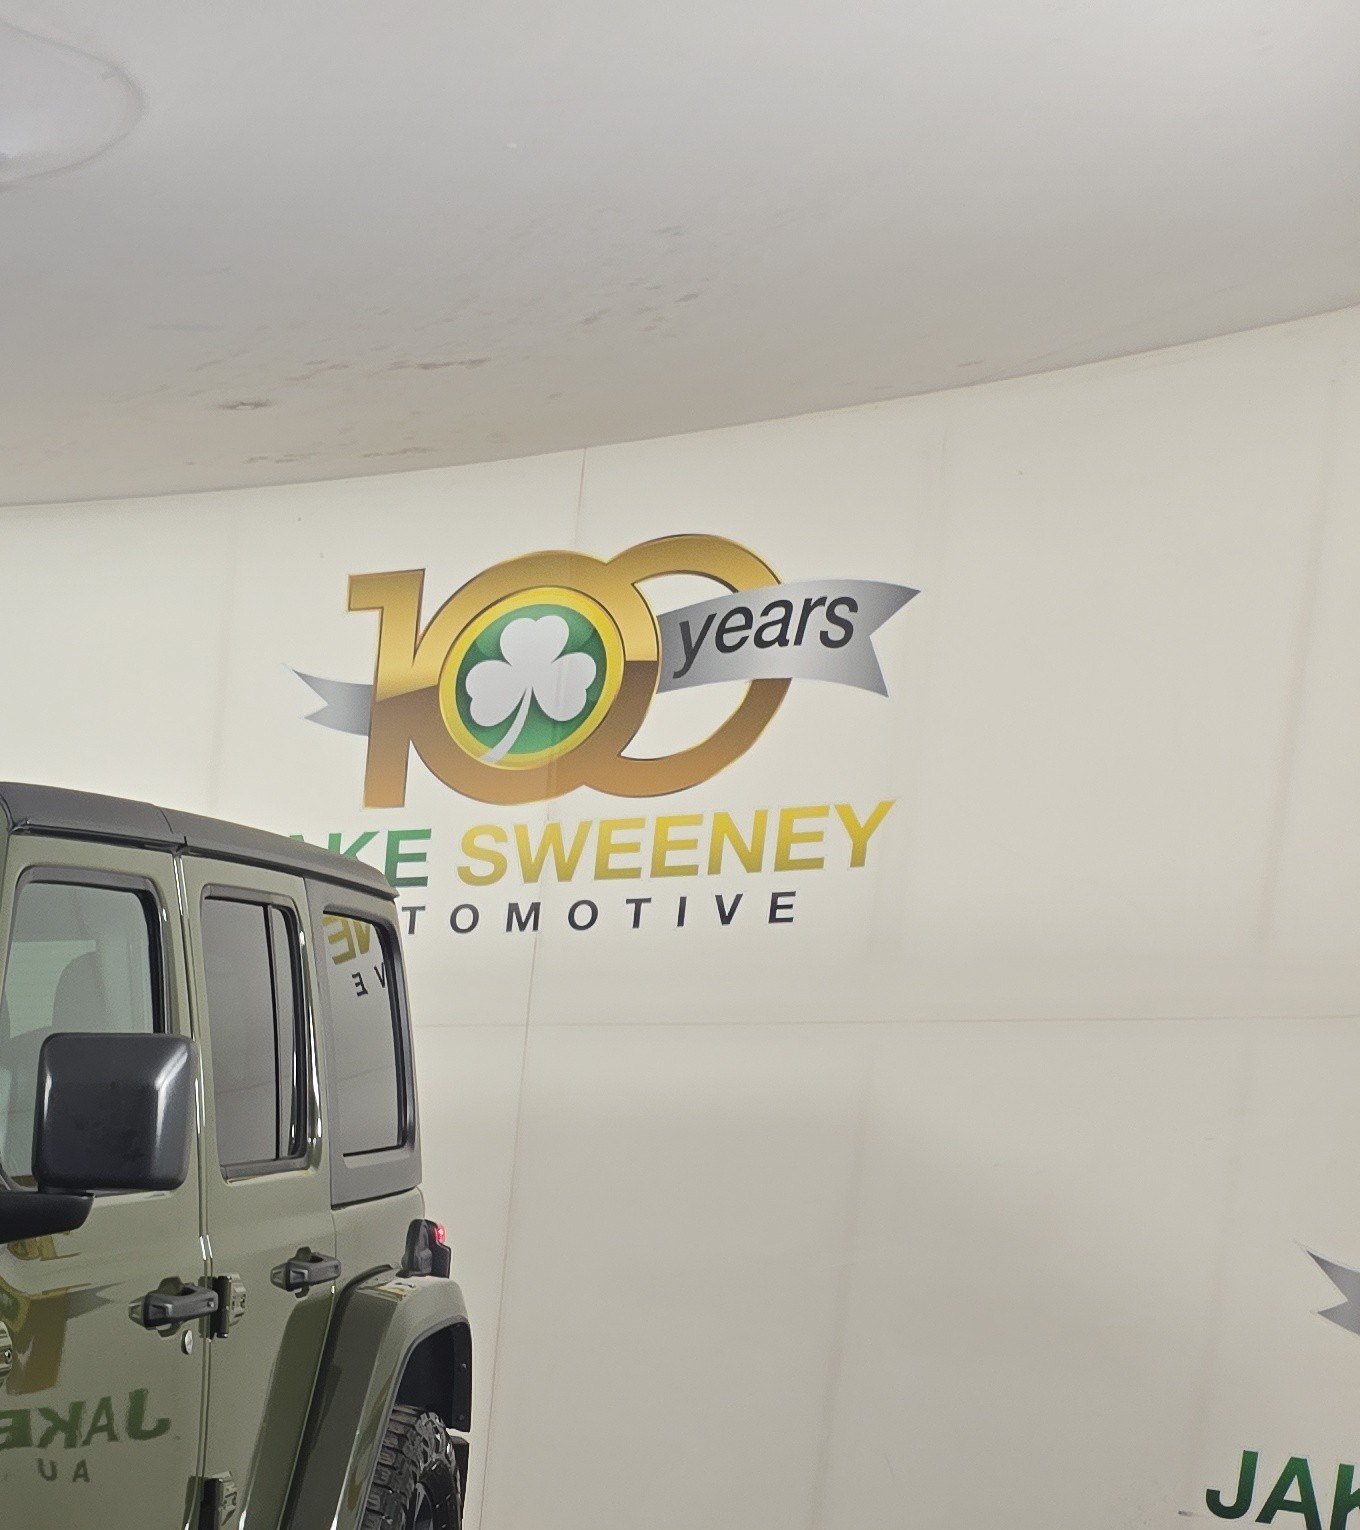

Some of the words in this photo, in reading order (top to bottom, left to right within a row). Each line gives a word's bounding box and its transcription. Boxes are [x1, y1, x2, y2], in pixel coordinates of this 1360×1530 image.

[347, 533, 792, 809] 100
[673, 593, 859, 681] years
[457, 800, 896, 886] SWEENEY
[400, 890, 797, 936] TOMOTIVE
